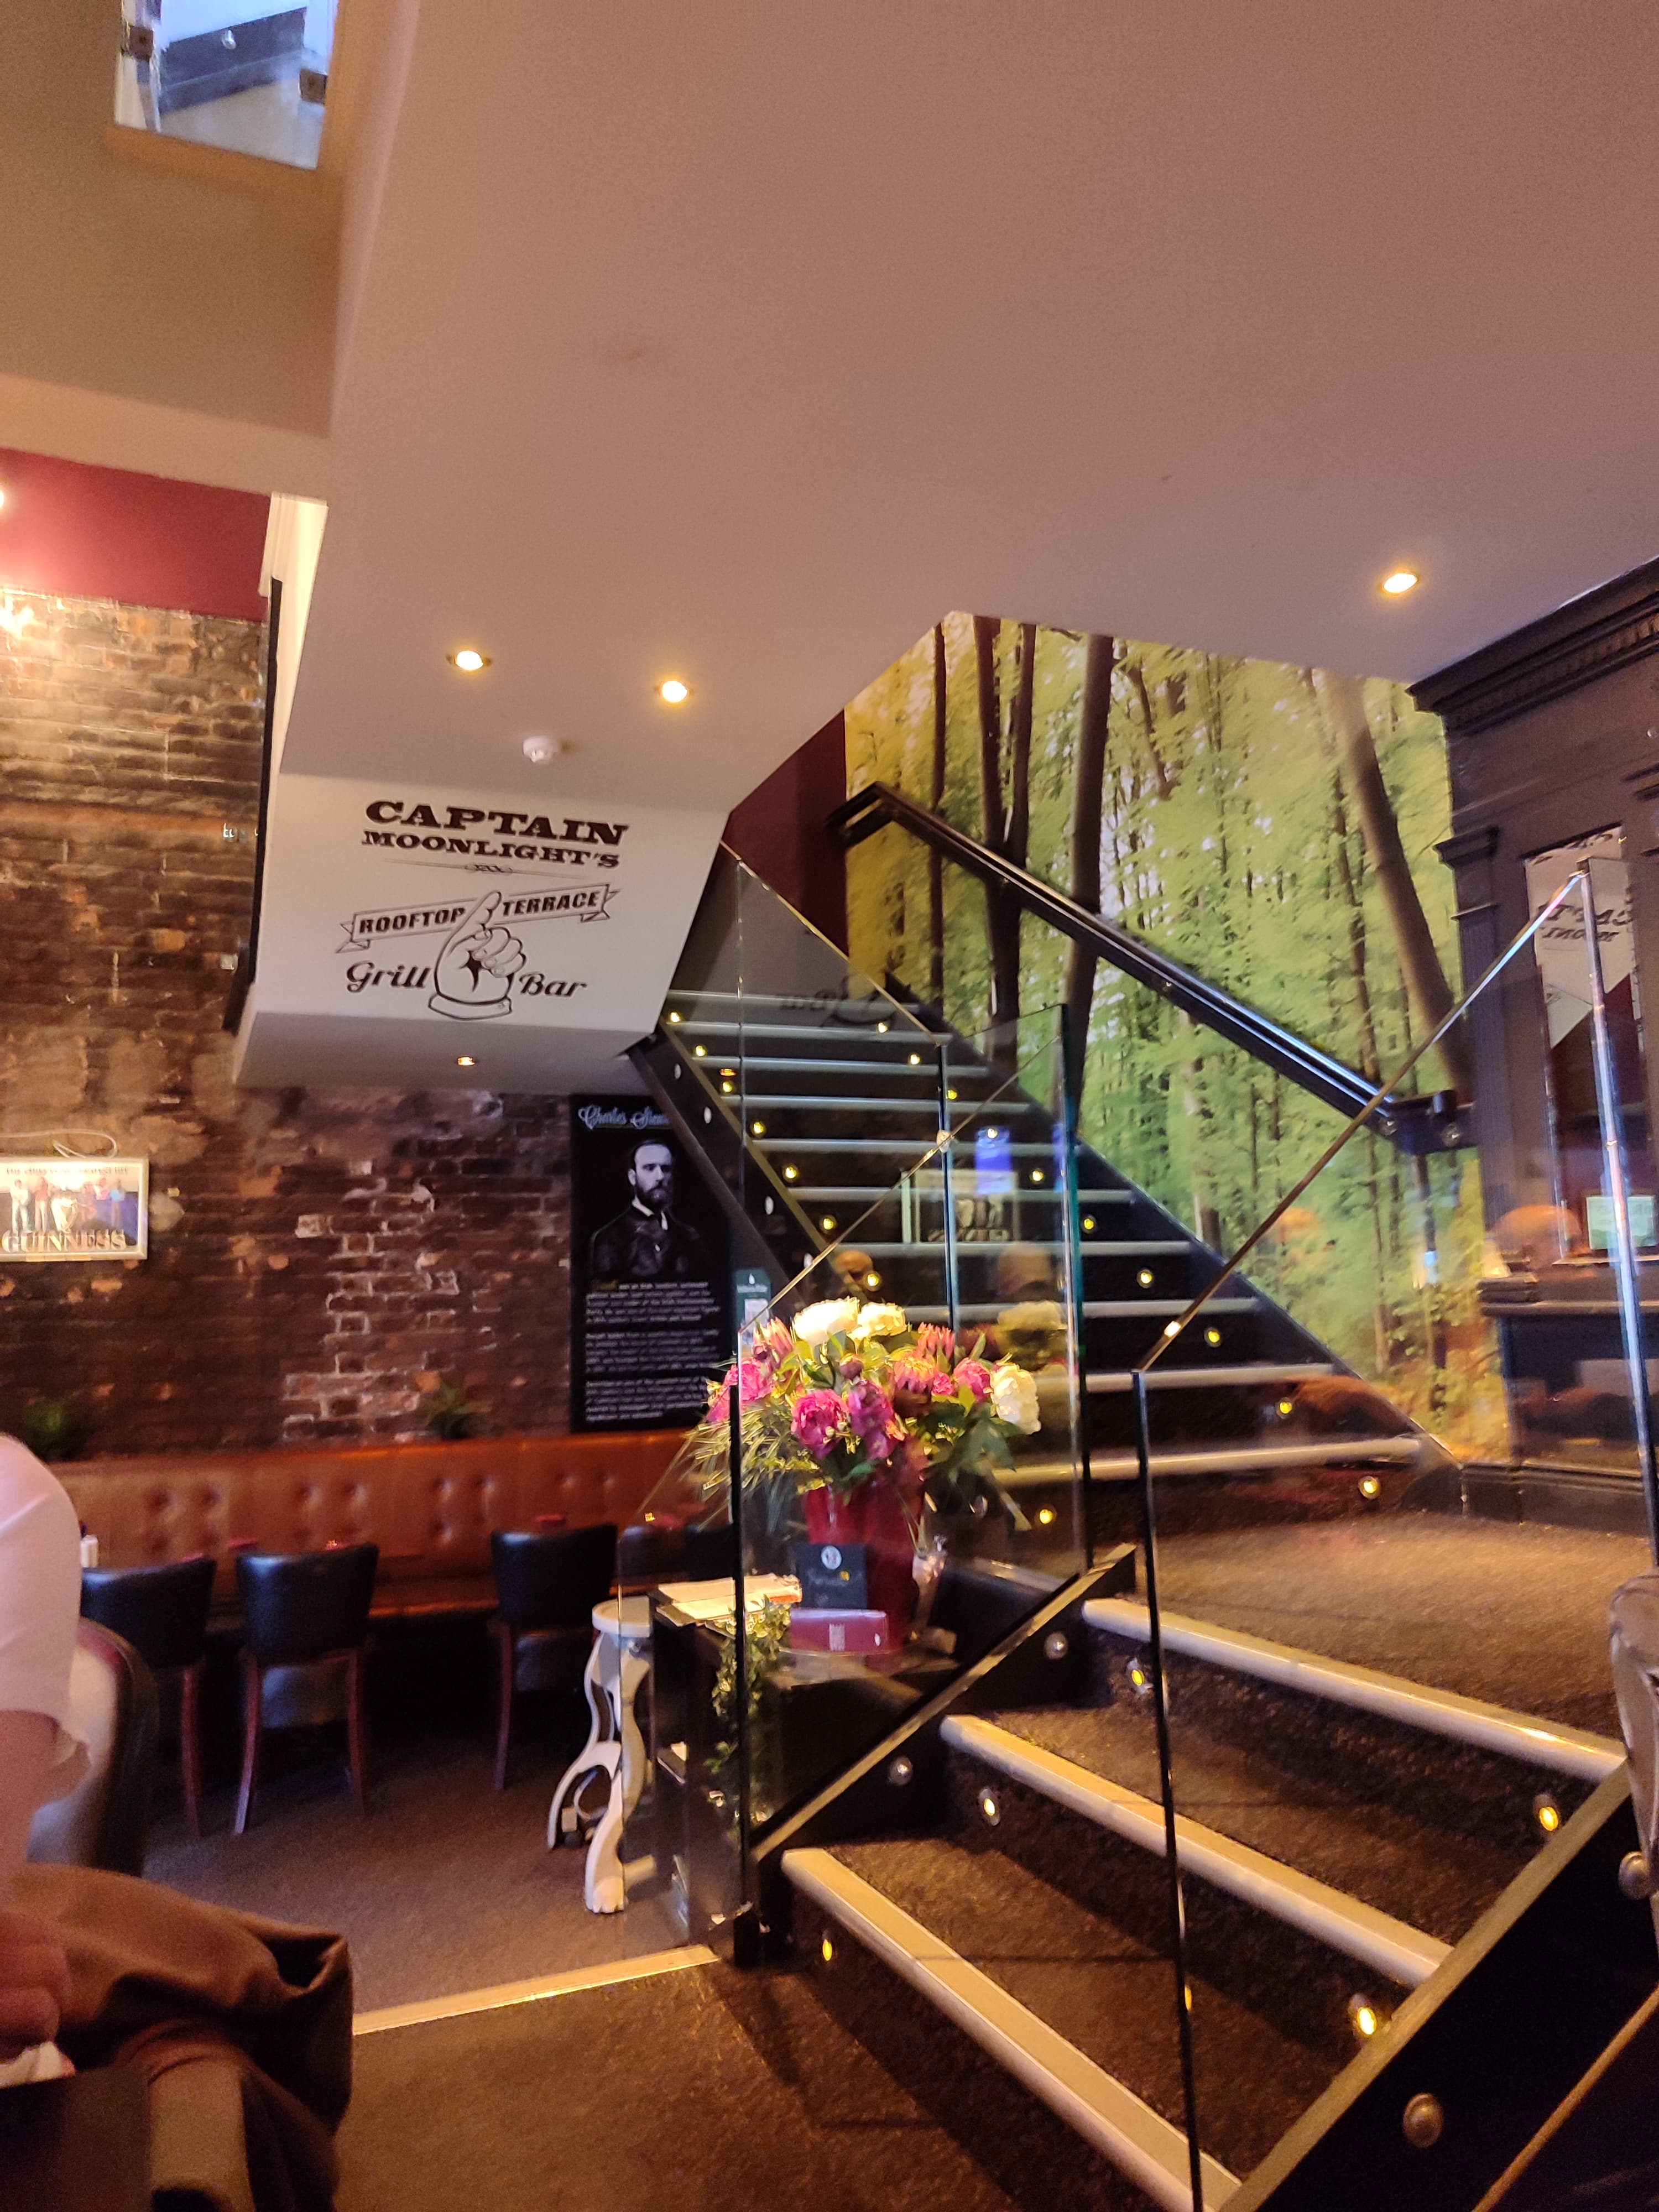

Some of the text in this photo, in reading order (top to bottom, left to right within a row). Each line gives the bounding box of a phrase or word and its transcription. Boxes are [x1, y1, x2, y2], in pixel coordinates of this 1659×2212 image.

[366, 801, 629, 846] CAPTAIN
[362, 831, 619, 868] MOONLIGHT'S
[358, 891, 600, 934] ROOFTOP TERRACE
[346, 962, 587, 997] Grill Bar
[2, 1229, 127, 1253] GUINNESS
